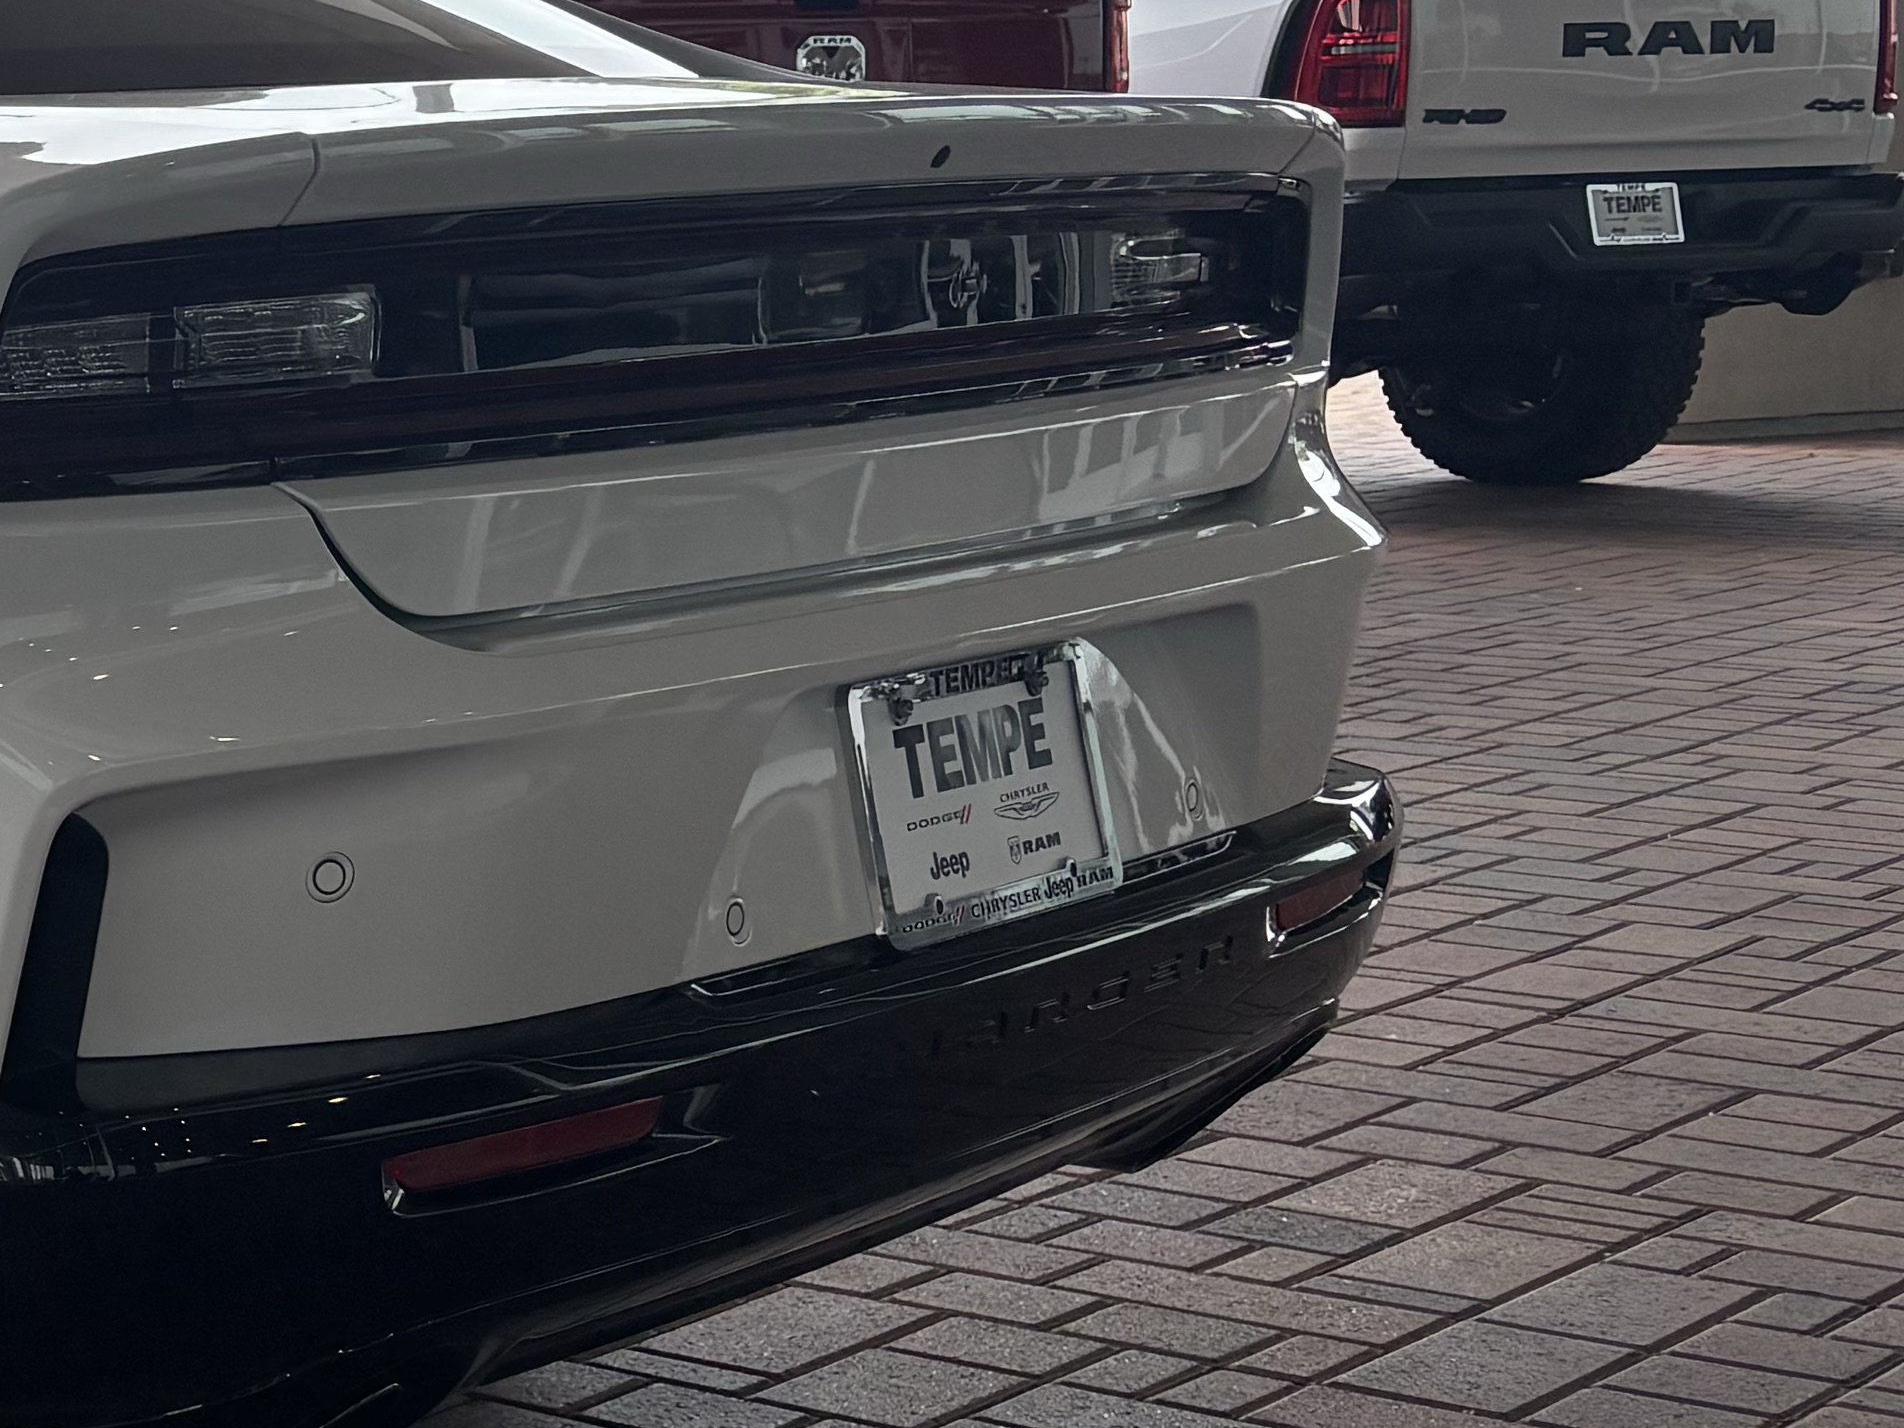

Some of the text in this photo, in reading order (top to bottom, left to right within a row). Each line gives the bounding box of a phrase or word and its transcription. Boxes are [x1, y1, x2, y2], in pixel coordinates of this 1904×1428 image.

[1562, 20, 1775, 57] RAM
[1603, 194, 1663, 214] TEMPE
[893, 698, 1053, 798] TEMPE
[1000, 782, 1051, 803] CHRYSLER
[906, 809, 963, 832] DODGE
[1023, 832, 1062, 855] RAM
[930, 851, 971, 880] Jeep
[971, 887, 1041, 919] CHRYSLER
[1044, 875, 1074, 899] Jeep
